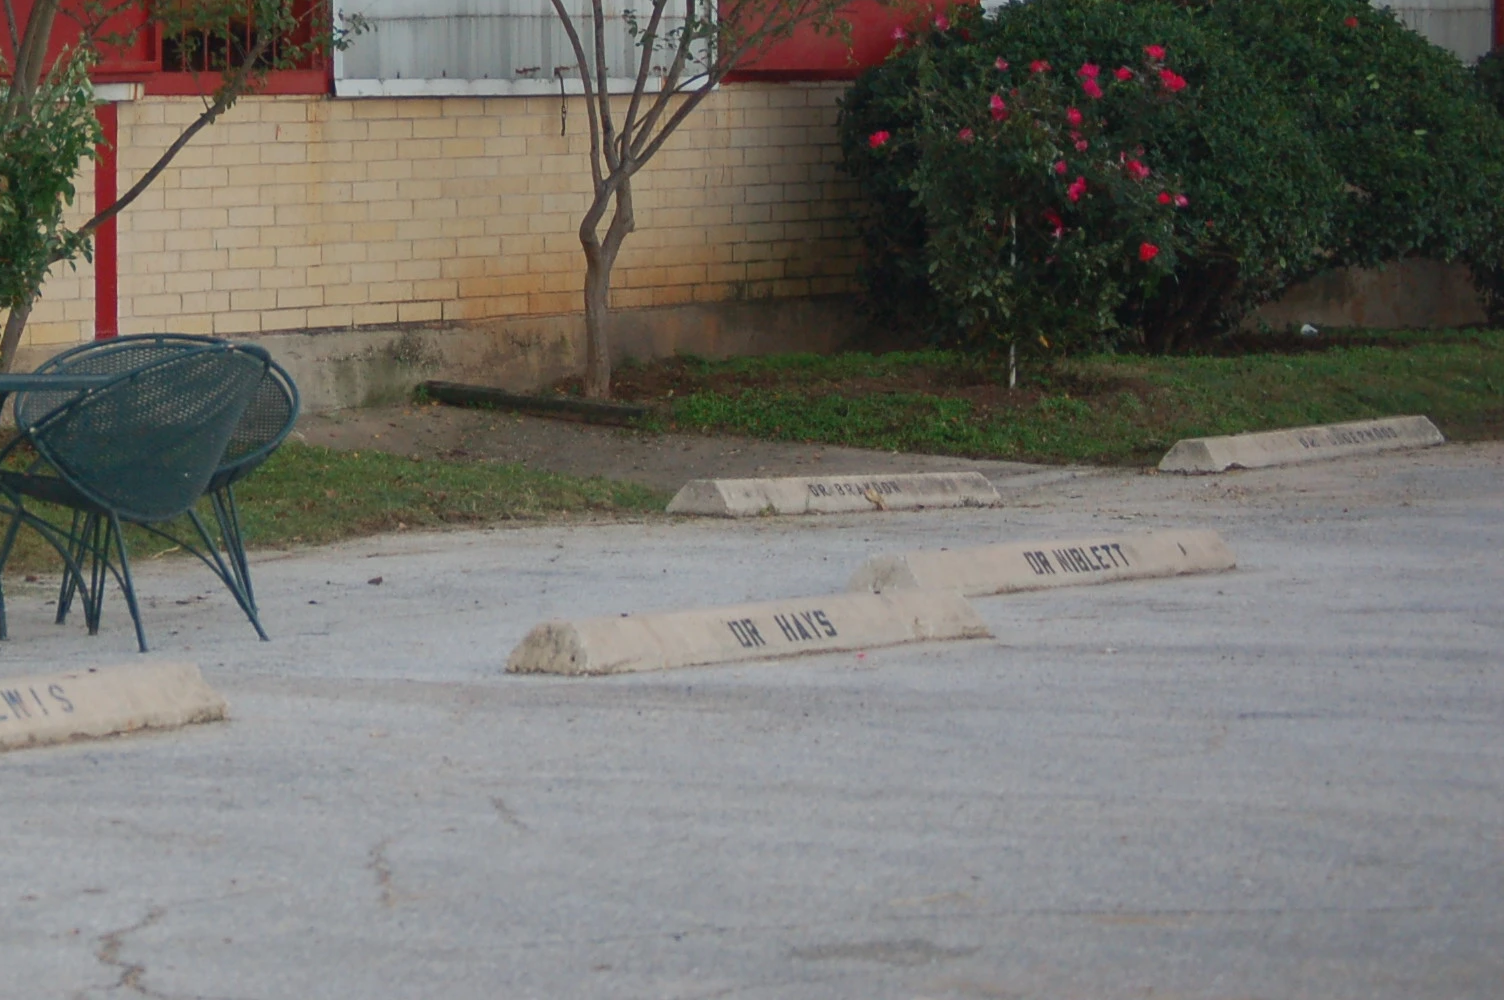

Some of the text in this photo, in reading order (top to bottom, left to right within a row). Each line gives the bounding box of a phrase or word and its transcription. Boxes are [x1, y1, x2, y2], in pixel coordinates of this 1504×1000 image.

[1023, 543, 1130, 575] DR NIBLETT
[727, 609, 838, 648] DR HAYS
